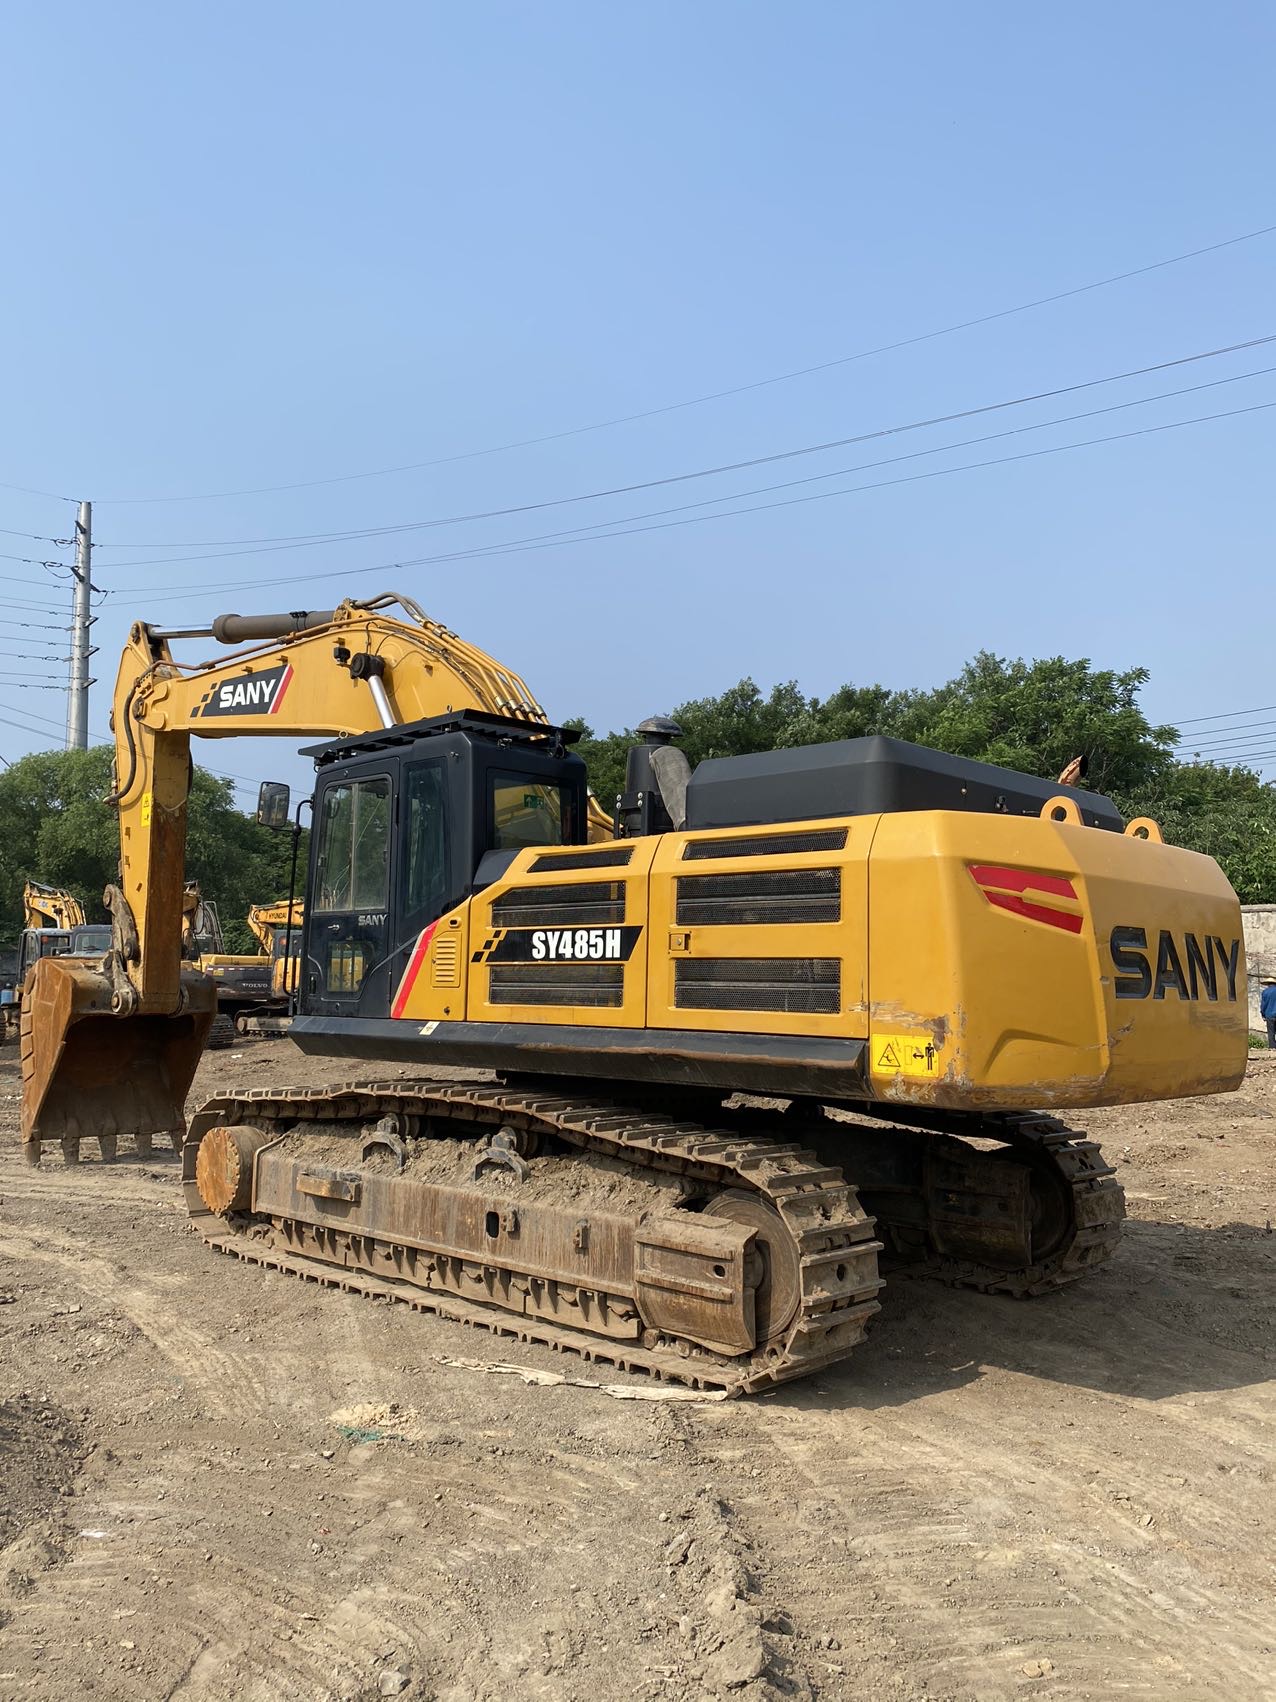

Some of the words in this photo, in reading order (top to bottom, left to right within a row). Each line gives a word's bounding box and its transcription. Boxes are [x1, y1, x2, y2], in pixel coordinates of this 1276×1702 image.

[219, 679, 277, 709] SANY
[358, 914, 387, 926] SANY
[531, 929, 621, 959] SY485H
[1110, 926, 1240, 1001] SANY
